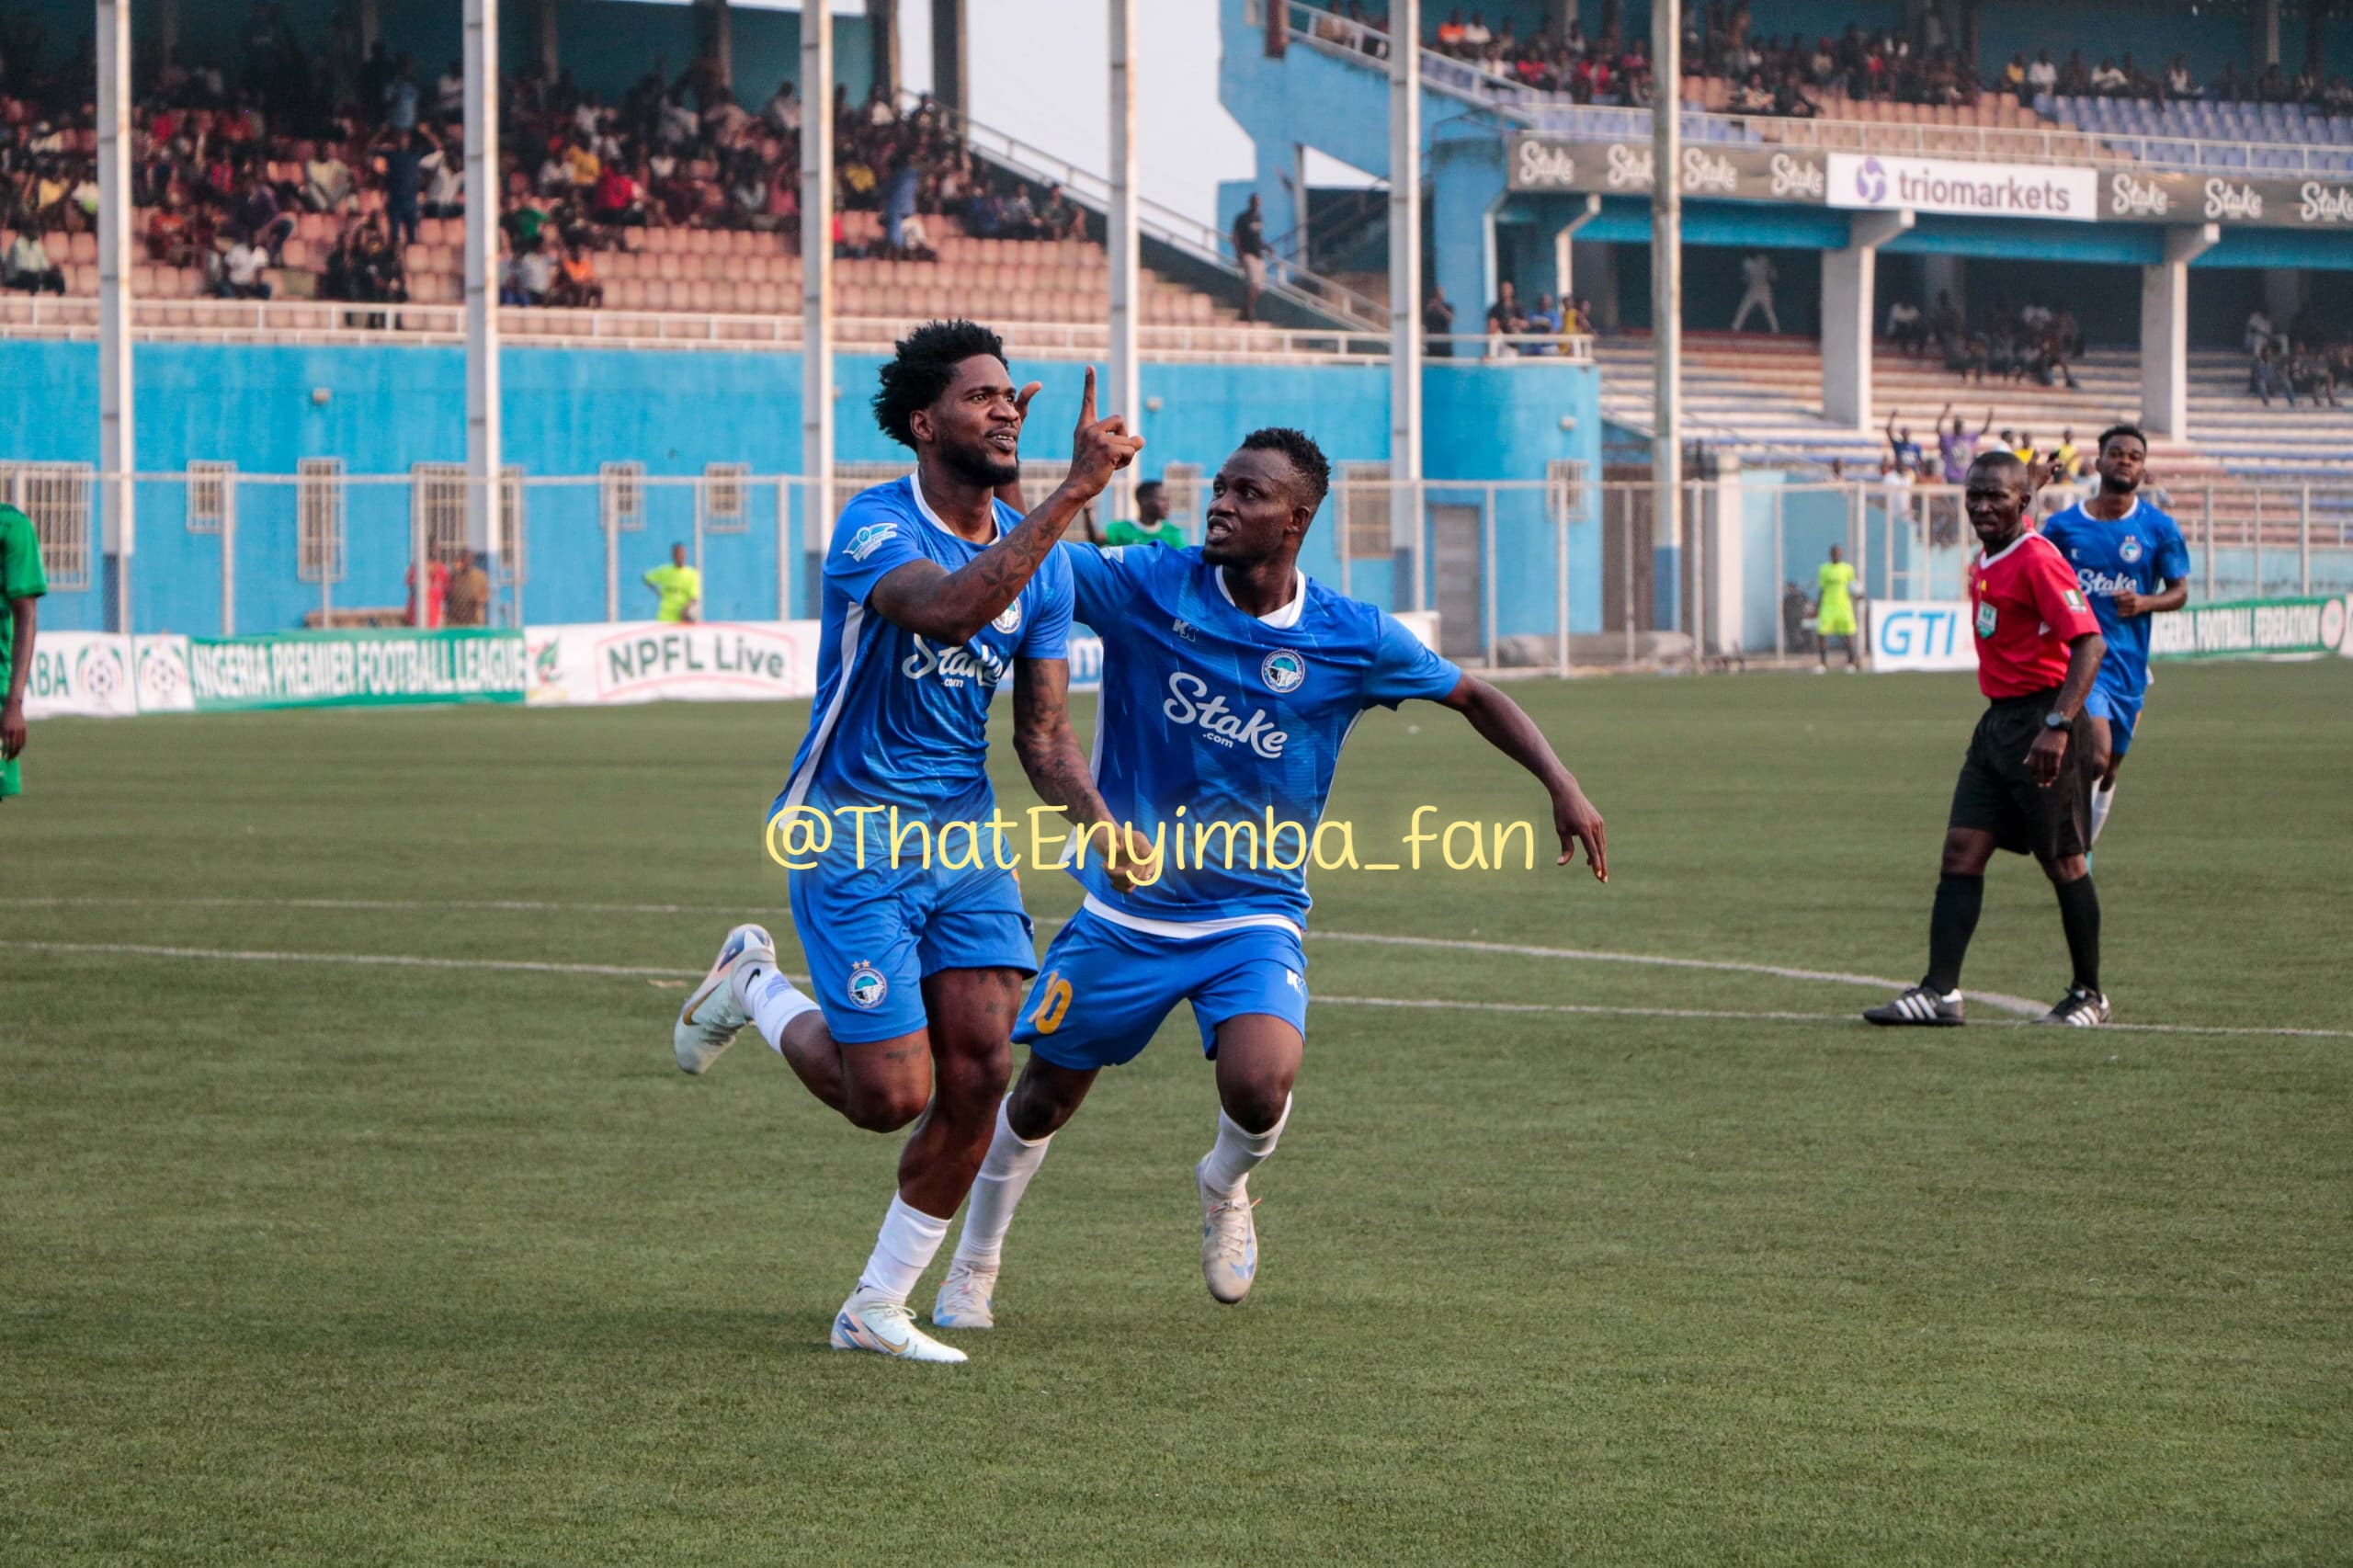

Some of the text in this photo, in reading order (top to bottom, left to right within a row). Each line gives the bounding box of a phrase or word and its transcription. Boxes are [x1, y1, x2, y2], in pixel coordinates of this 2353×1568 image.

[1898, 167, 2070, 212] triomarkets
[2112, 174, 2168, 215] Stake
[2205, 177, 2263, 220] Stake
[2078, 568, 2138, 596] Stake
[1881, 610, 1958, 658] GTI
[192, 638, 525, 697] NIGERIA PREMIER FOOTBALL LEAGUE
[609, 634, 786, 682] NPFL Live
[1163, 671, 1289, 759] Stake
[1202, 732, 1234, 749] .com
